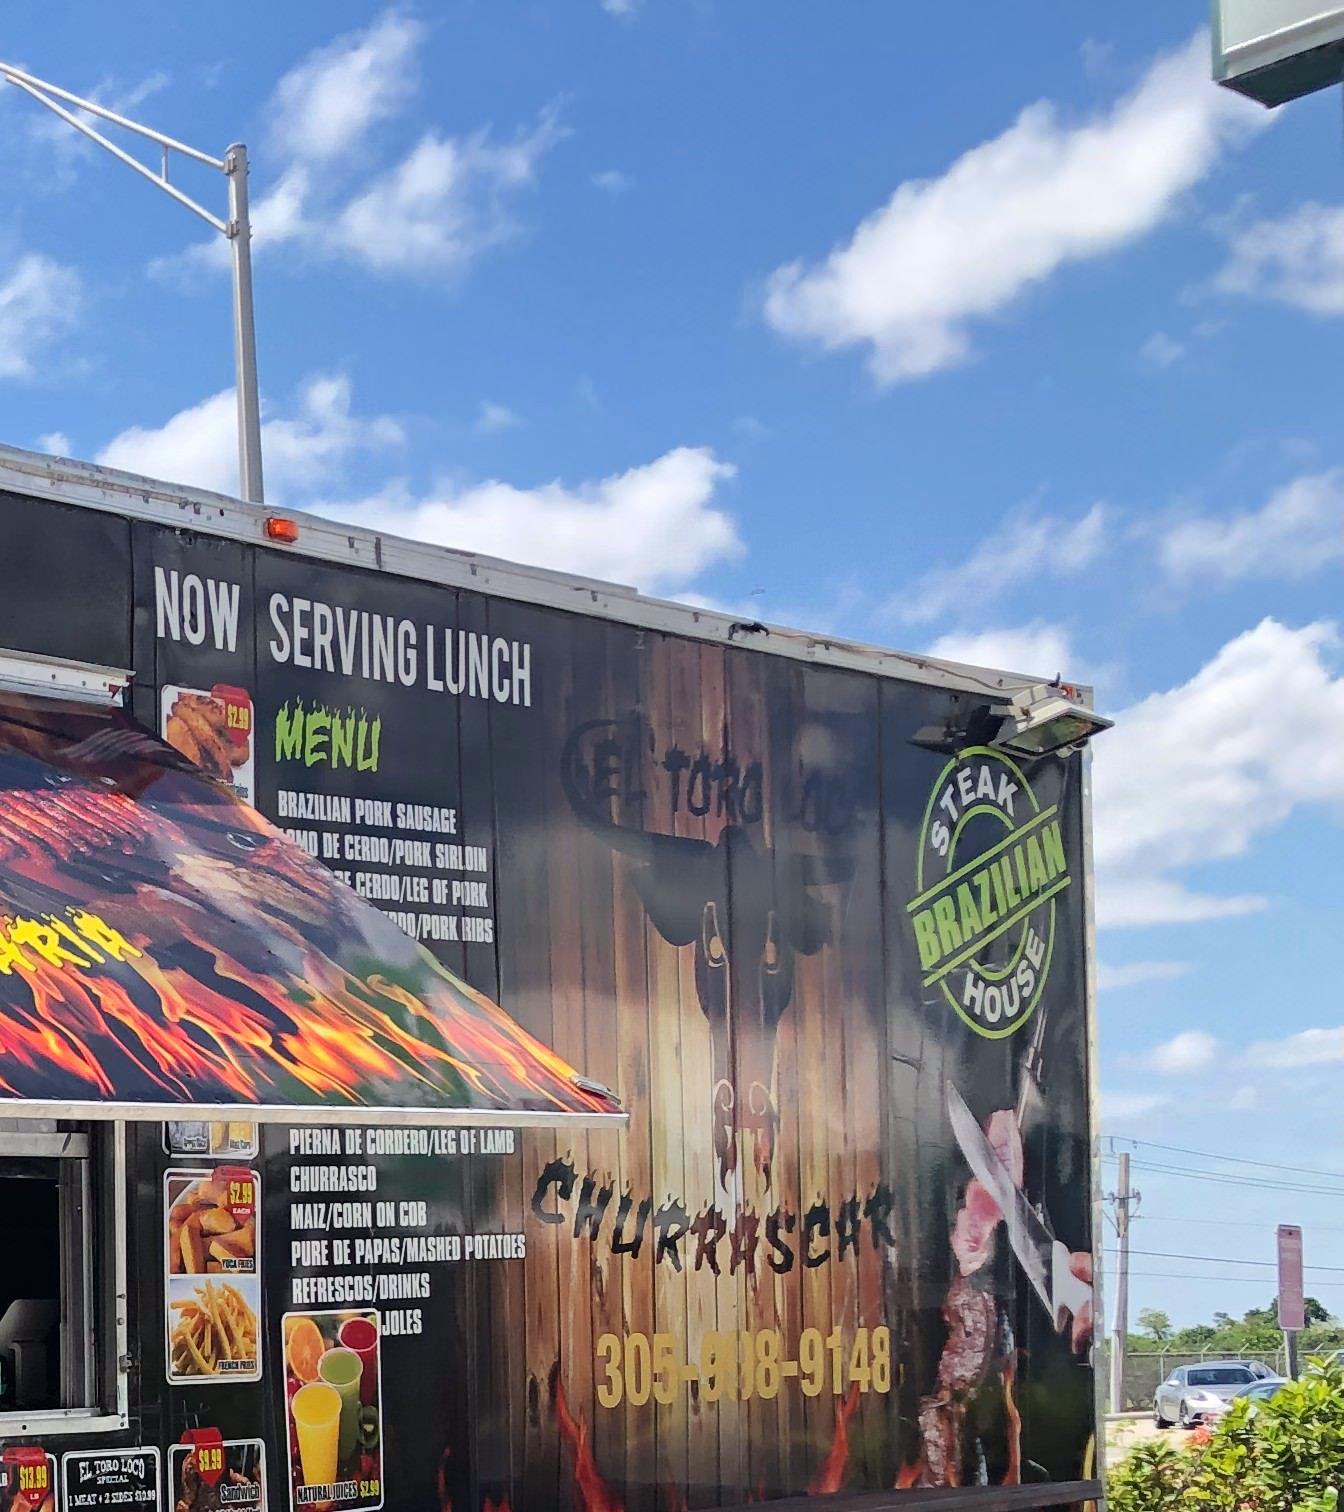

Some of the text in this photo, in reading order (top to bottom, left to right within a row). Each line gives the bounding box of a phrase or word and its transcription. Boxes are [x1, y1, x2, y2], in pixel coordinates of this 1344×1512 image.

[155, 566, 531, 706] NOW SERVING LUNCH
[275, 695, 382, 773] MENU
[278, 790, 456, 834] BRAZILIAN PORK SAUSAGE
[931, 766, 1017, 856] STEAK
[323, 833, 340, 859] DE
[345, 836, 432, 867] CERDO/PORK
[436, 844, 487, 872] SIRLOIN
[356, 872, 429, 904] CERDO/LEG
[433, 878, 448, 904] OF
[452, 881, 488, 907] PORK
[913, 820, 1067, 970] BRAZILIAN
[464, 917, 493, 943] RIBS
[964, 927, 1045, 1022] HOUSE
[290, 1128, 514, 1156] PIERNA DE CORDERO/LEG OF LAMB
[291, 1166, 376, 1192] CHURRASCO
[291, 1201, 427, 1231] MAIZ/CORN ON COB
[292, 1234, 525, 1266] PURE DE PAPAS/MASHED POTATOES
[293, 1273, 430, 1304] REFRESCOS/DRINKS
[79, 1458, 144, 1483] EL TORO LOCO
[199, 1449, 222, 1472] $9.99
[220, 1482, 260, 1503] Sandwich
[297, 1480, 380, 1503] NATURAL JUICES $2.99
